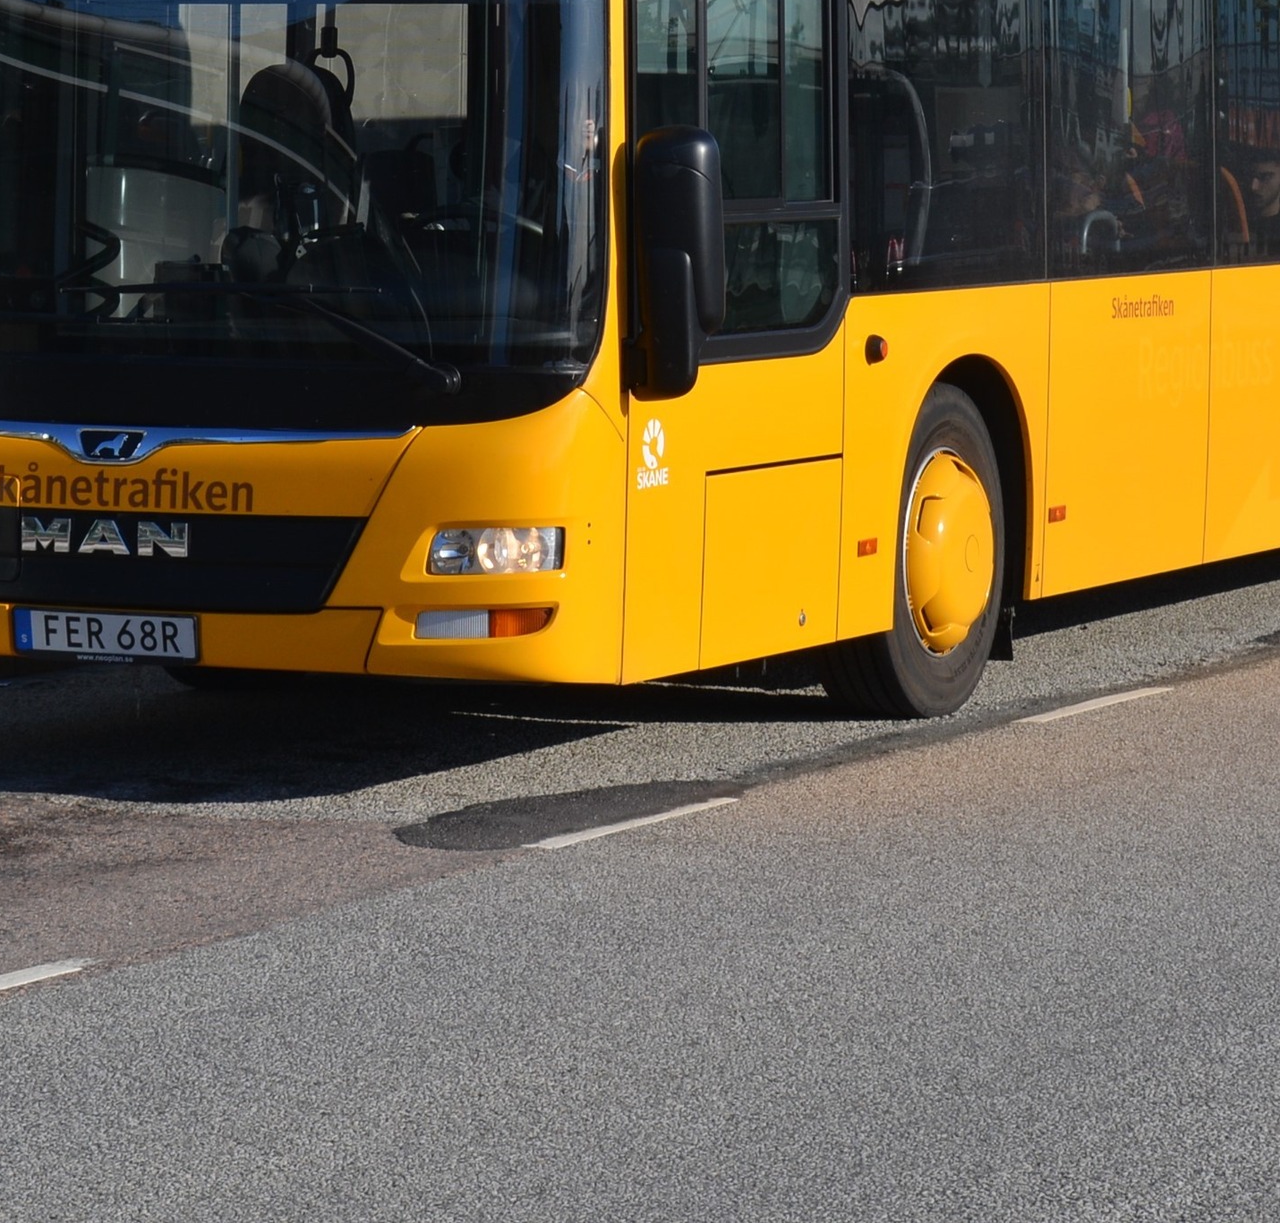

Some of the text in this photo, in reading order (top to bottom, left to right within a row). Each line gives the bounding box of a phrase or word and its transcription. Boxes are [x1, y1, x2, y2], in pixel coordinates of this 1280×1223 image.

[1111, 294, 1174, 319] Skånetrafiken
[21, 516, 189, 558] MAN
[21, 633, 28, 643] S
[43, 614, 182, 654] FER 68R
[76, 653, 134, 664] www.neoplan.se
